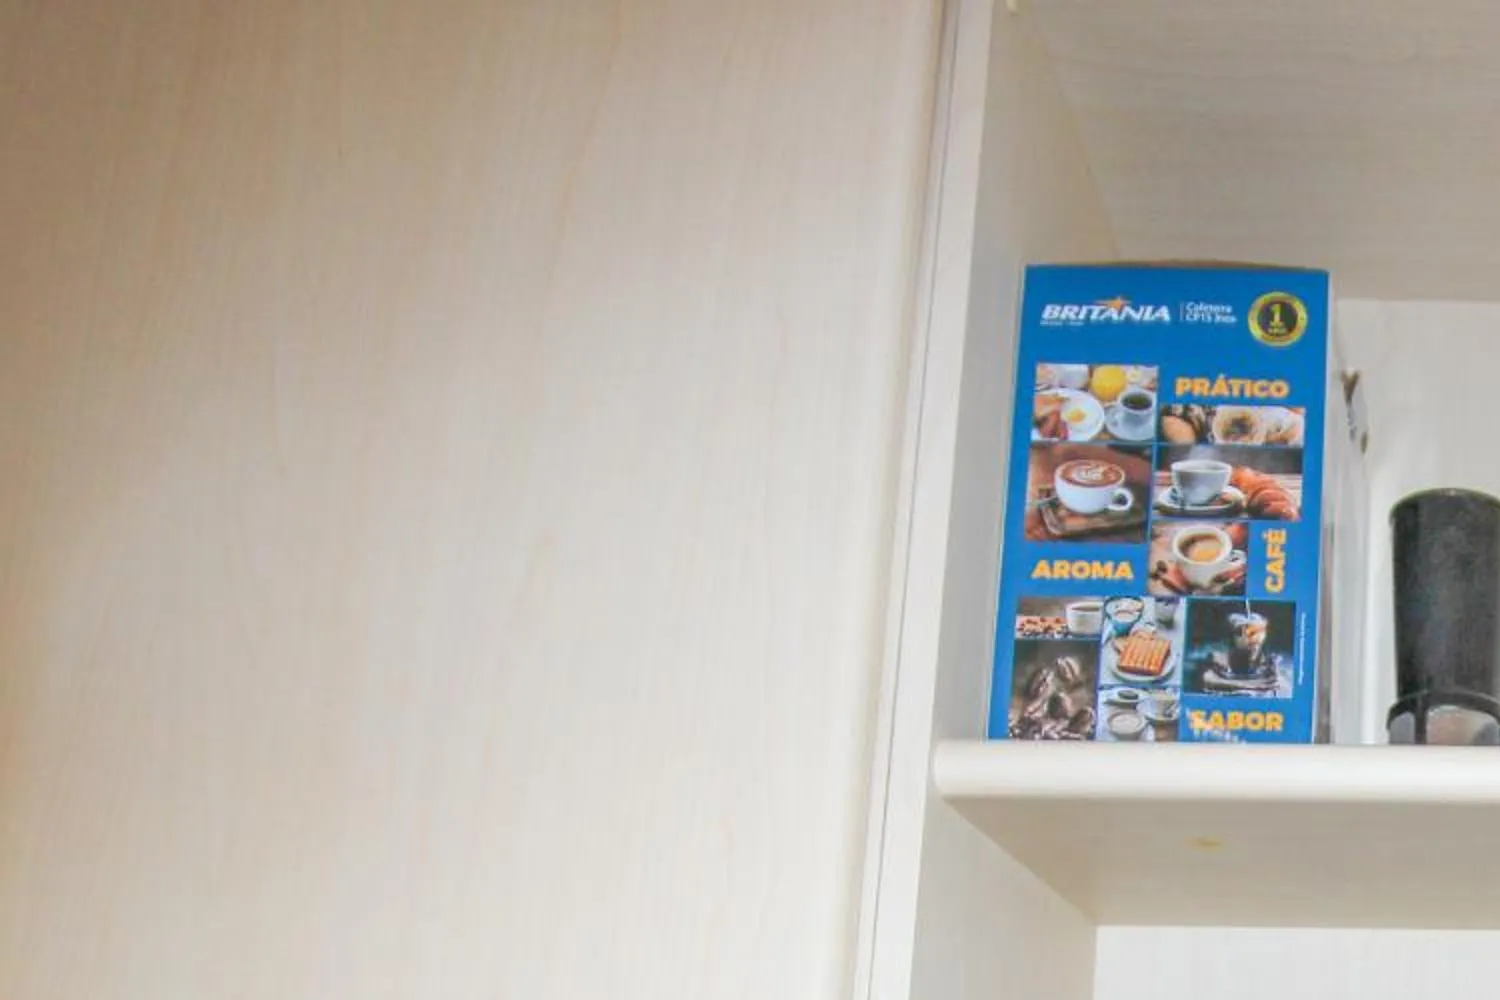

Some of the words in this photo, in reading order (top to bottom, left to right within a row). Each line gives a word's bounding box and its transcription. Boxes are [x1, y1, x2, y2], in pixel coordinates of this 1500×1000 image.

[1174, 373, 1290, 398] PRÁTICO
[1031, 559, 1134, 580] AROMA
[1261, 527, 1287, 594] CAFÉ
[1189, 709, 1284, 732] SABOR
